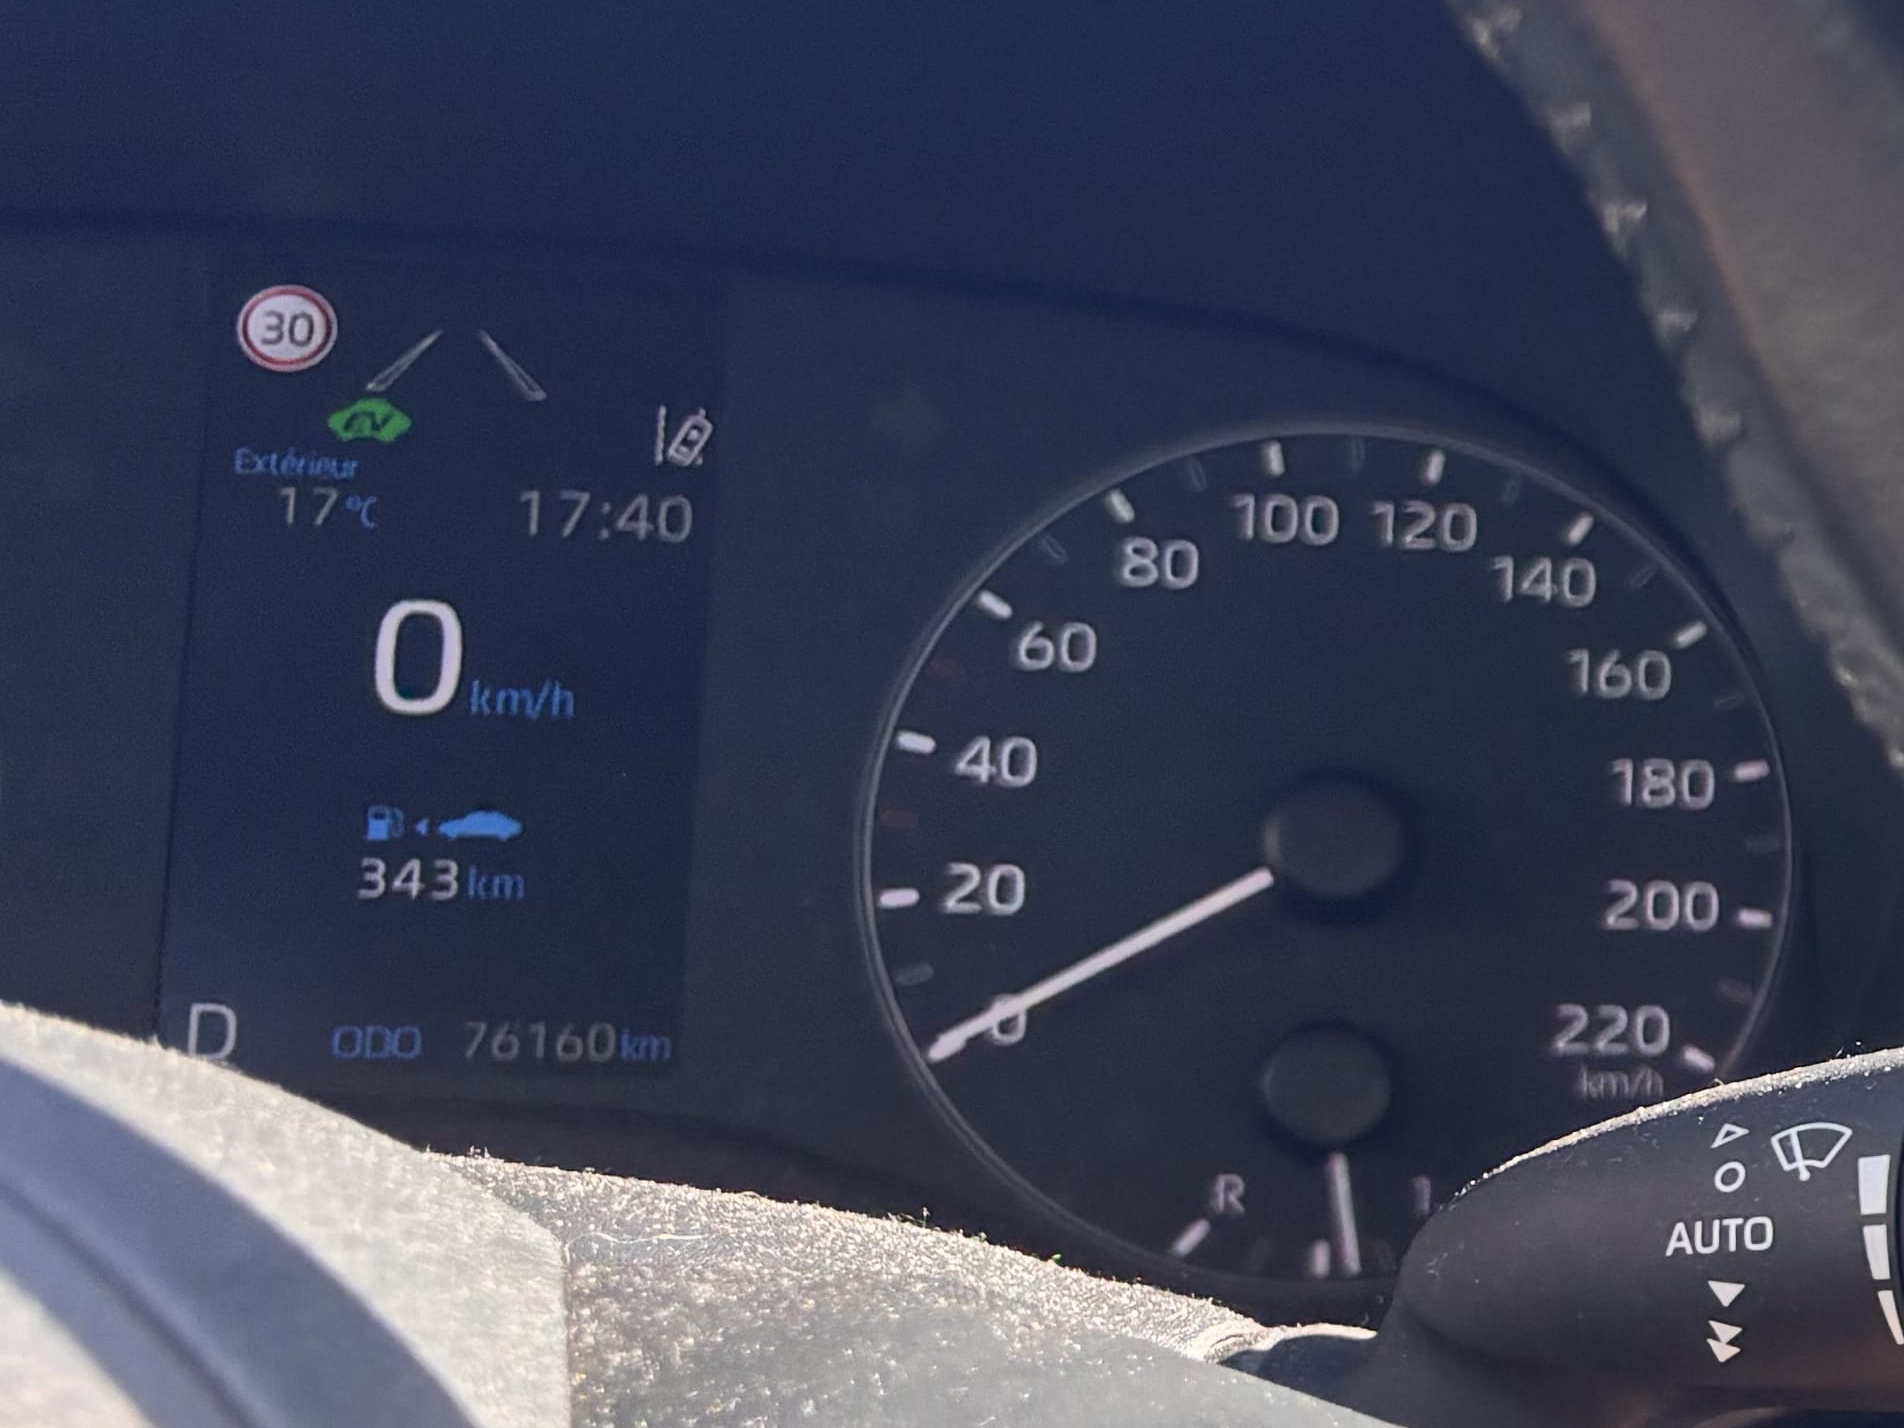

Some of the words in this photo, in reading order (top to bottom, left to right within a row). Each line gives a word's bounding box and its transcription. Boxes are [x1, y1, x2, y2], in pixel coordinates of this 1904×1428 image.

[260, 310, 315, 347] 30
[519, 489, 693, 544] 17:40
[1230, 494, 1341, 546] 100
[1370, 501, 1478, 553] 120
[1121, 537, 1200, 591] 80
[1490, 555, 1599, 608] 140
[374, 599, 463, 717] 0
[469, 679, 576, 721] km/h
[1017, 619, 1099, 674] 60
[1566, 648, 1674, 701] 160
[955, 735, 1039, 788] 40
[1611, 758, 1716, 811] 180
[941, 863, 1026, 916] 20
[1605, 880, 1720, 932] 200
[186, 1002, 238, 1061] D
[331, 1024, 422, 1060] ODO
[1551, 1003, 1672, 1058] 220
[1210, 1173, 1247, 1215] R
[1665, 1215, 1775, 1257] AUTO
